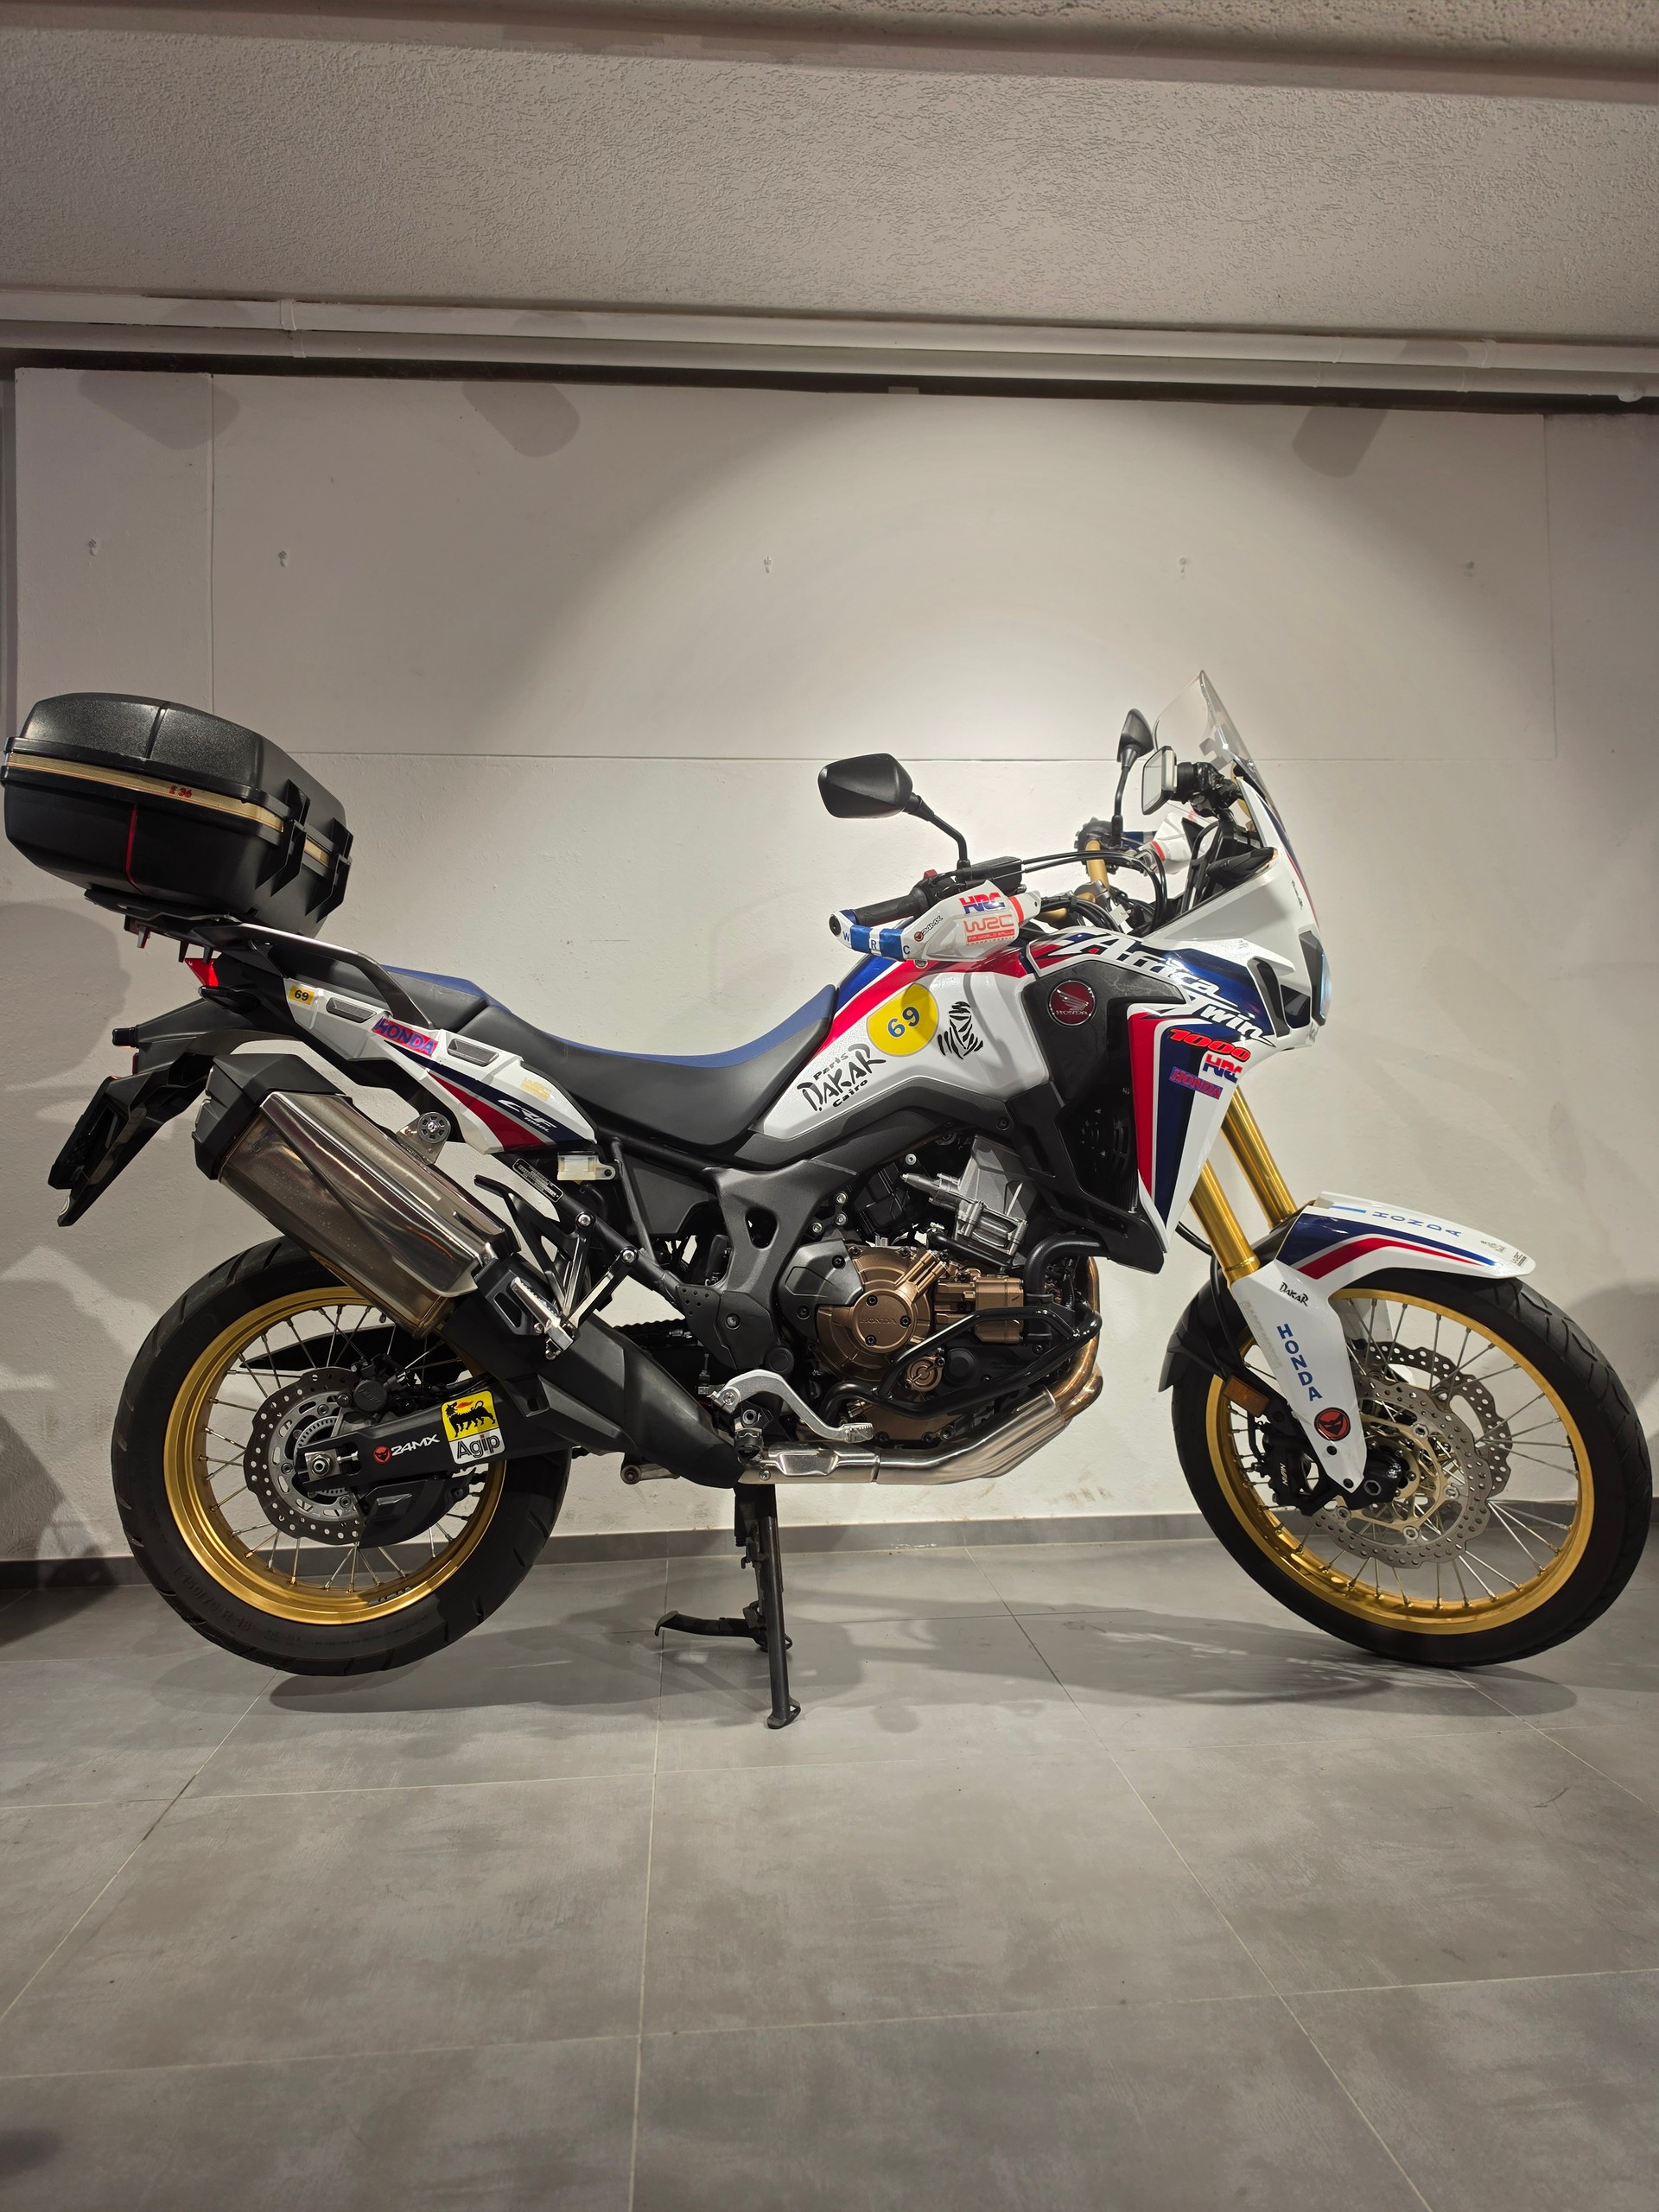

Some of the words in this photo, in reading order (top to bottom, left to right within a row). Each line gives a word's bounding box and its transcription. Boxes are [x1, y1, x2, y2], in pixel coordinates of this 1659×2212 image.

[959, 892, 1006, 914] HRC
[963, 914, 1014, 933] WRC
[842, 931, 851, 942] W
[870, 939, 878, 950] R
[902, 945, 911, 955] C
[1048, 933, 1238, 1007] Africa
[294, 989, 309, 1001] 69
[373, 1016, 435, 1056] HONDA
[887, 1006, 921, 1038] 69
[1168, 1027, 1252, 1063] 1000
[796, 1043, 887, 1112] DAKAR
[1202, 1053, 1243, 1084] HRC
[832, 1079, 868, 1108] Cairo
[1170, 1068, 1222, 1100] HONDA
[497, 1099, 558, 1128] CRF
[1371, 1211, 1462, 1237] HONDA
[1279, 1281, 1309, 1307] DAKAR
[1276, 1323, 1324, 1402] HONDA
[391, 1433, 441, 1457] 24MX
[456, 1433, 501, 1460] Agip
